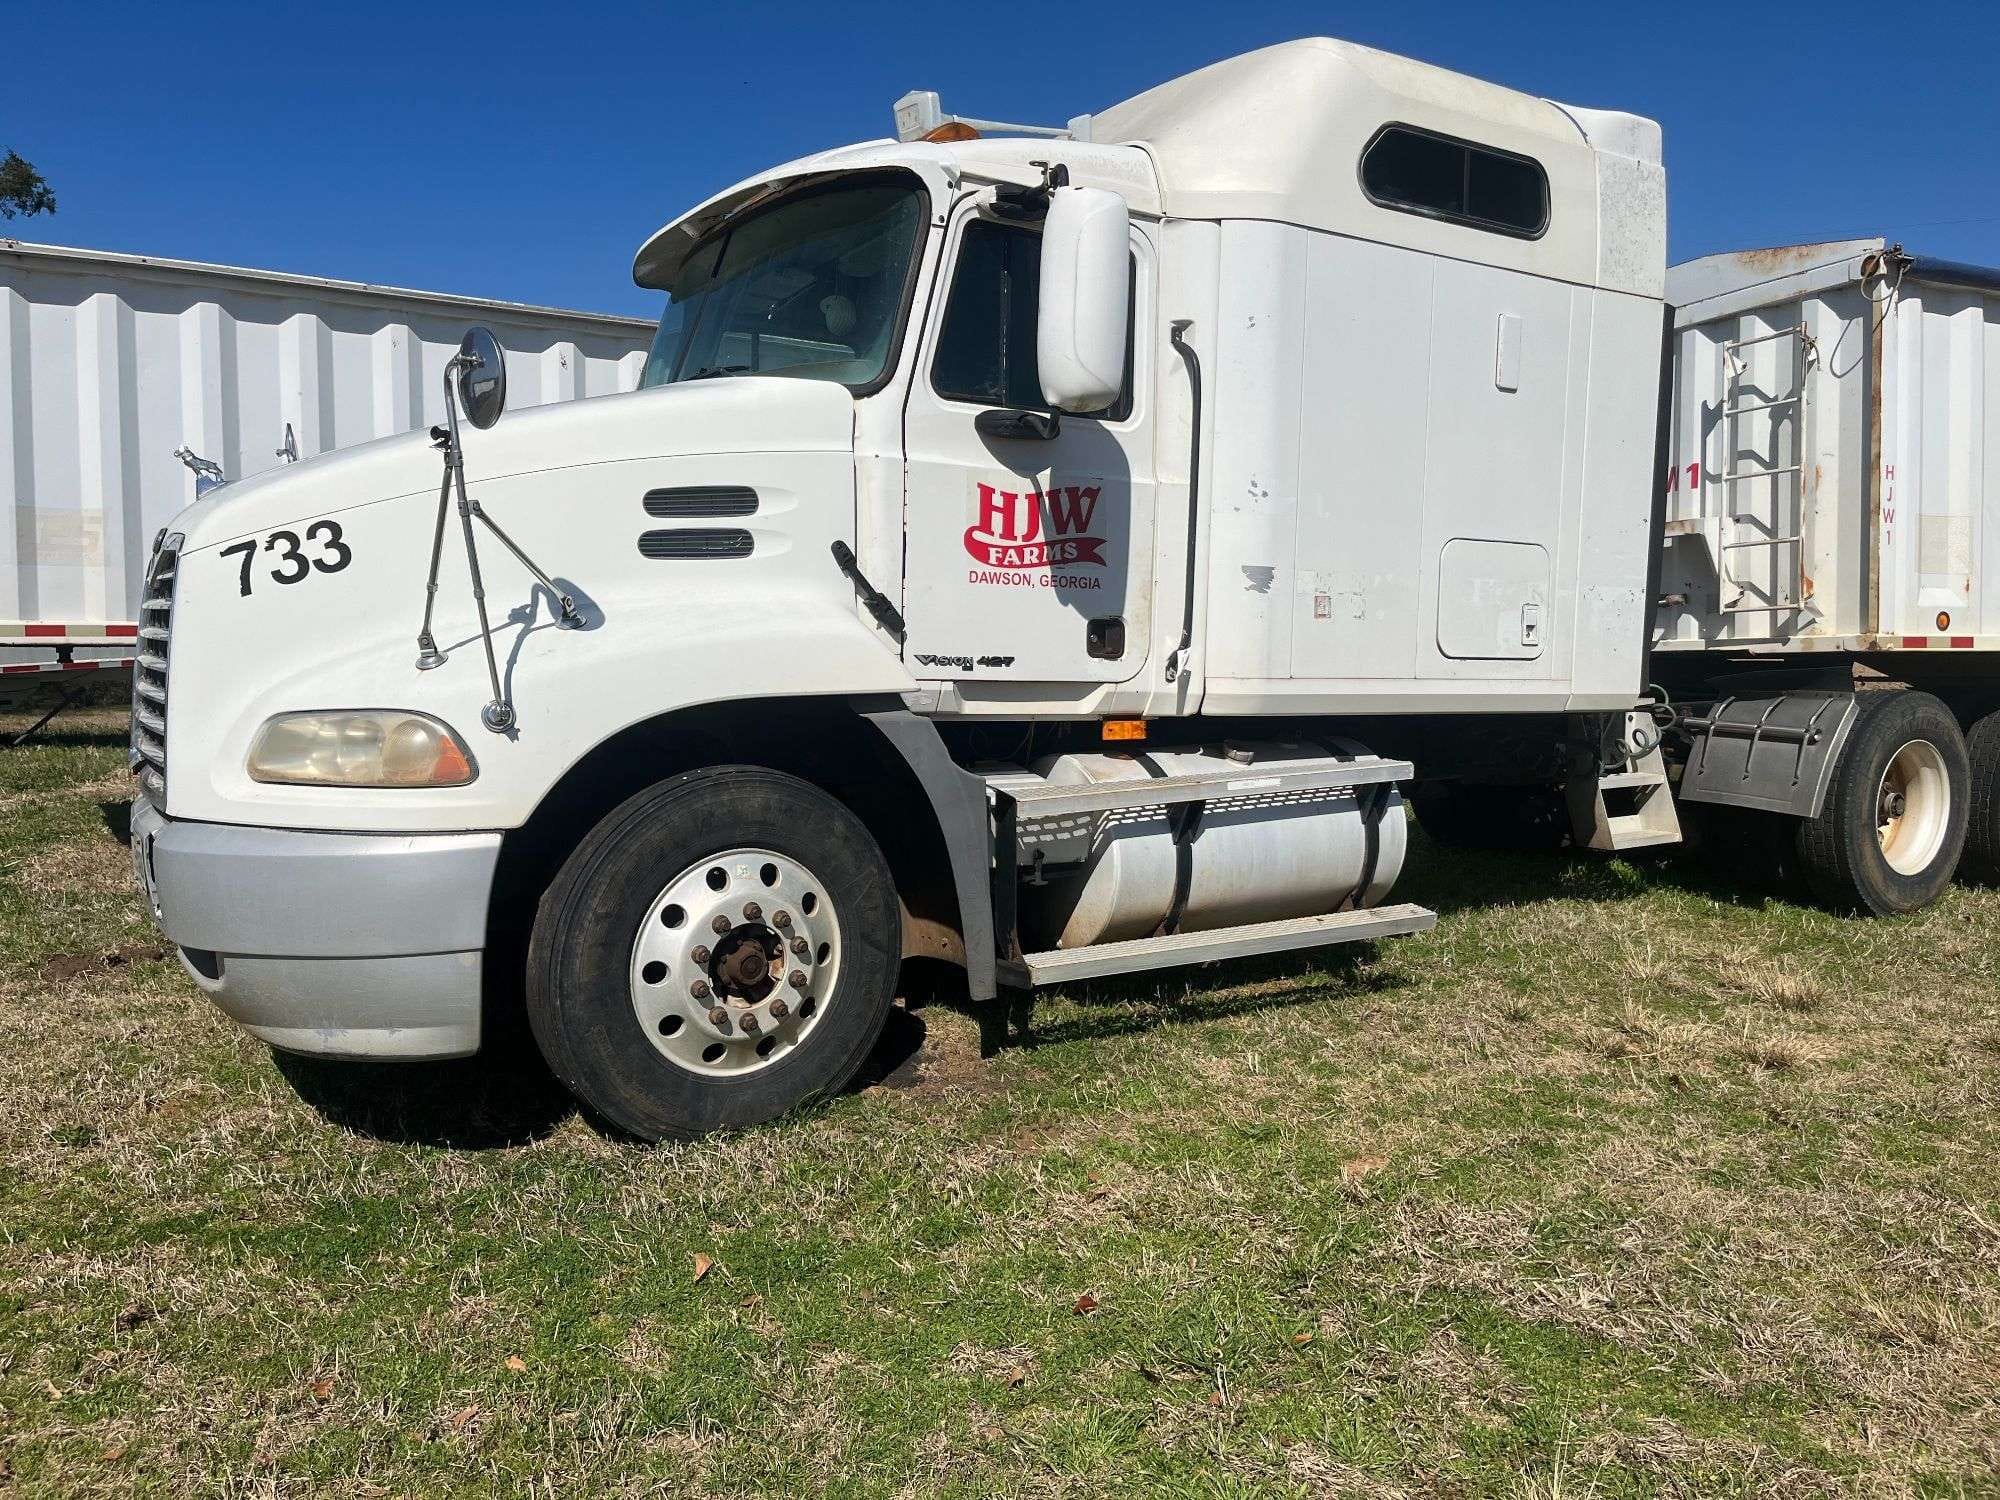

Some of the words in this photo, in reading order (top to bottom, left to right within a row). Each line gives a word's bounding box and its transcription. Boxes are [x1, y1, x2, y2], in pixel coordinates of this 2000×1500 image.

[977, 482, 1101, 542] HJW
[220, 519, 352, 597] 733
[988, 542, 1078, 565] FARMS
[969, 570, 1035, 588] DAWSON,
[1040, 574, 1101, 589] GEORGIA
